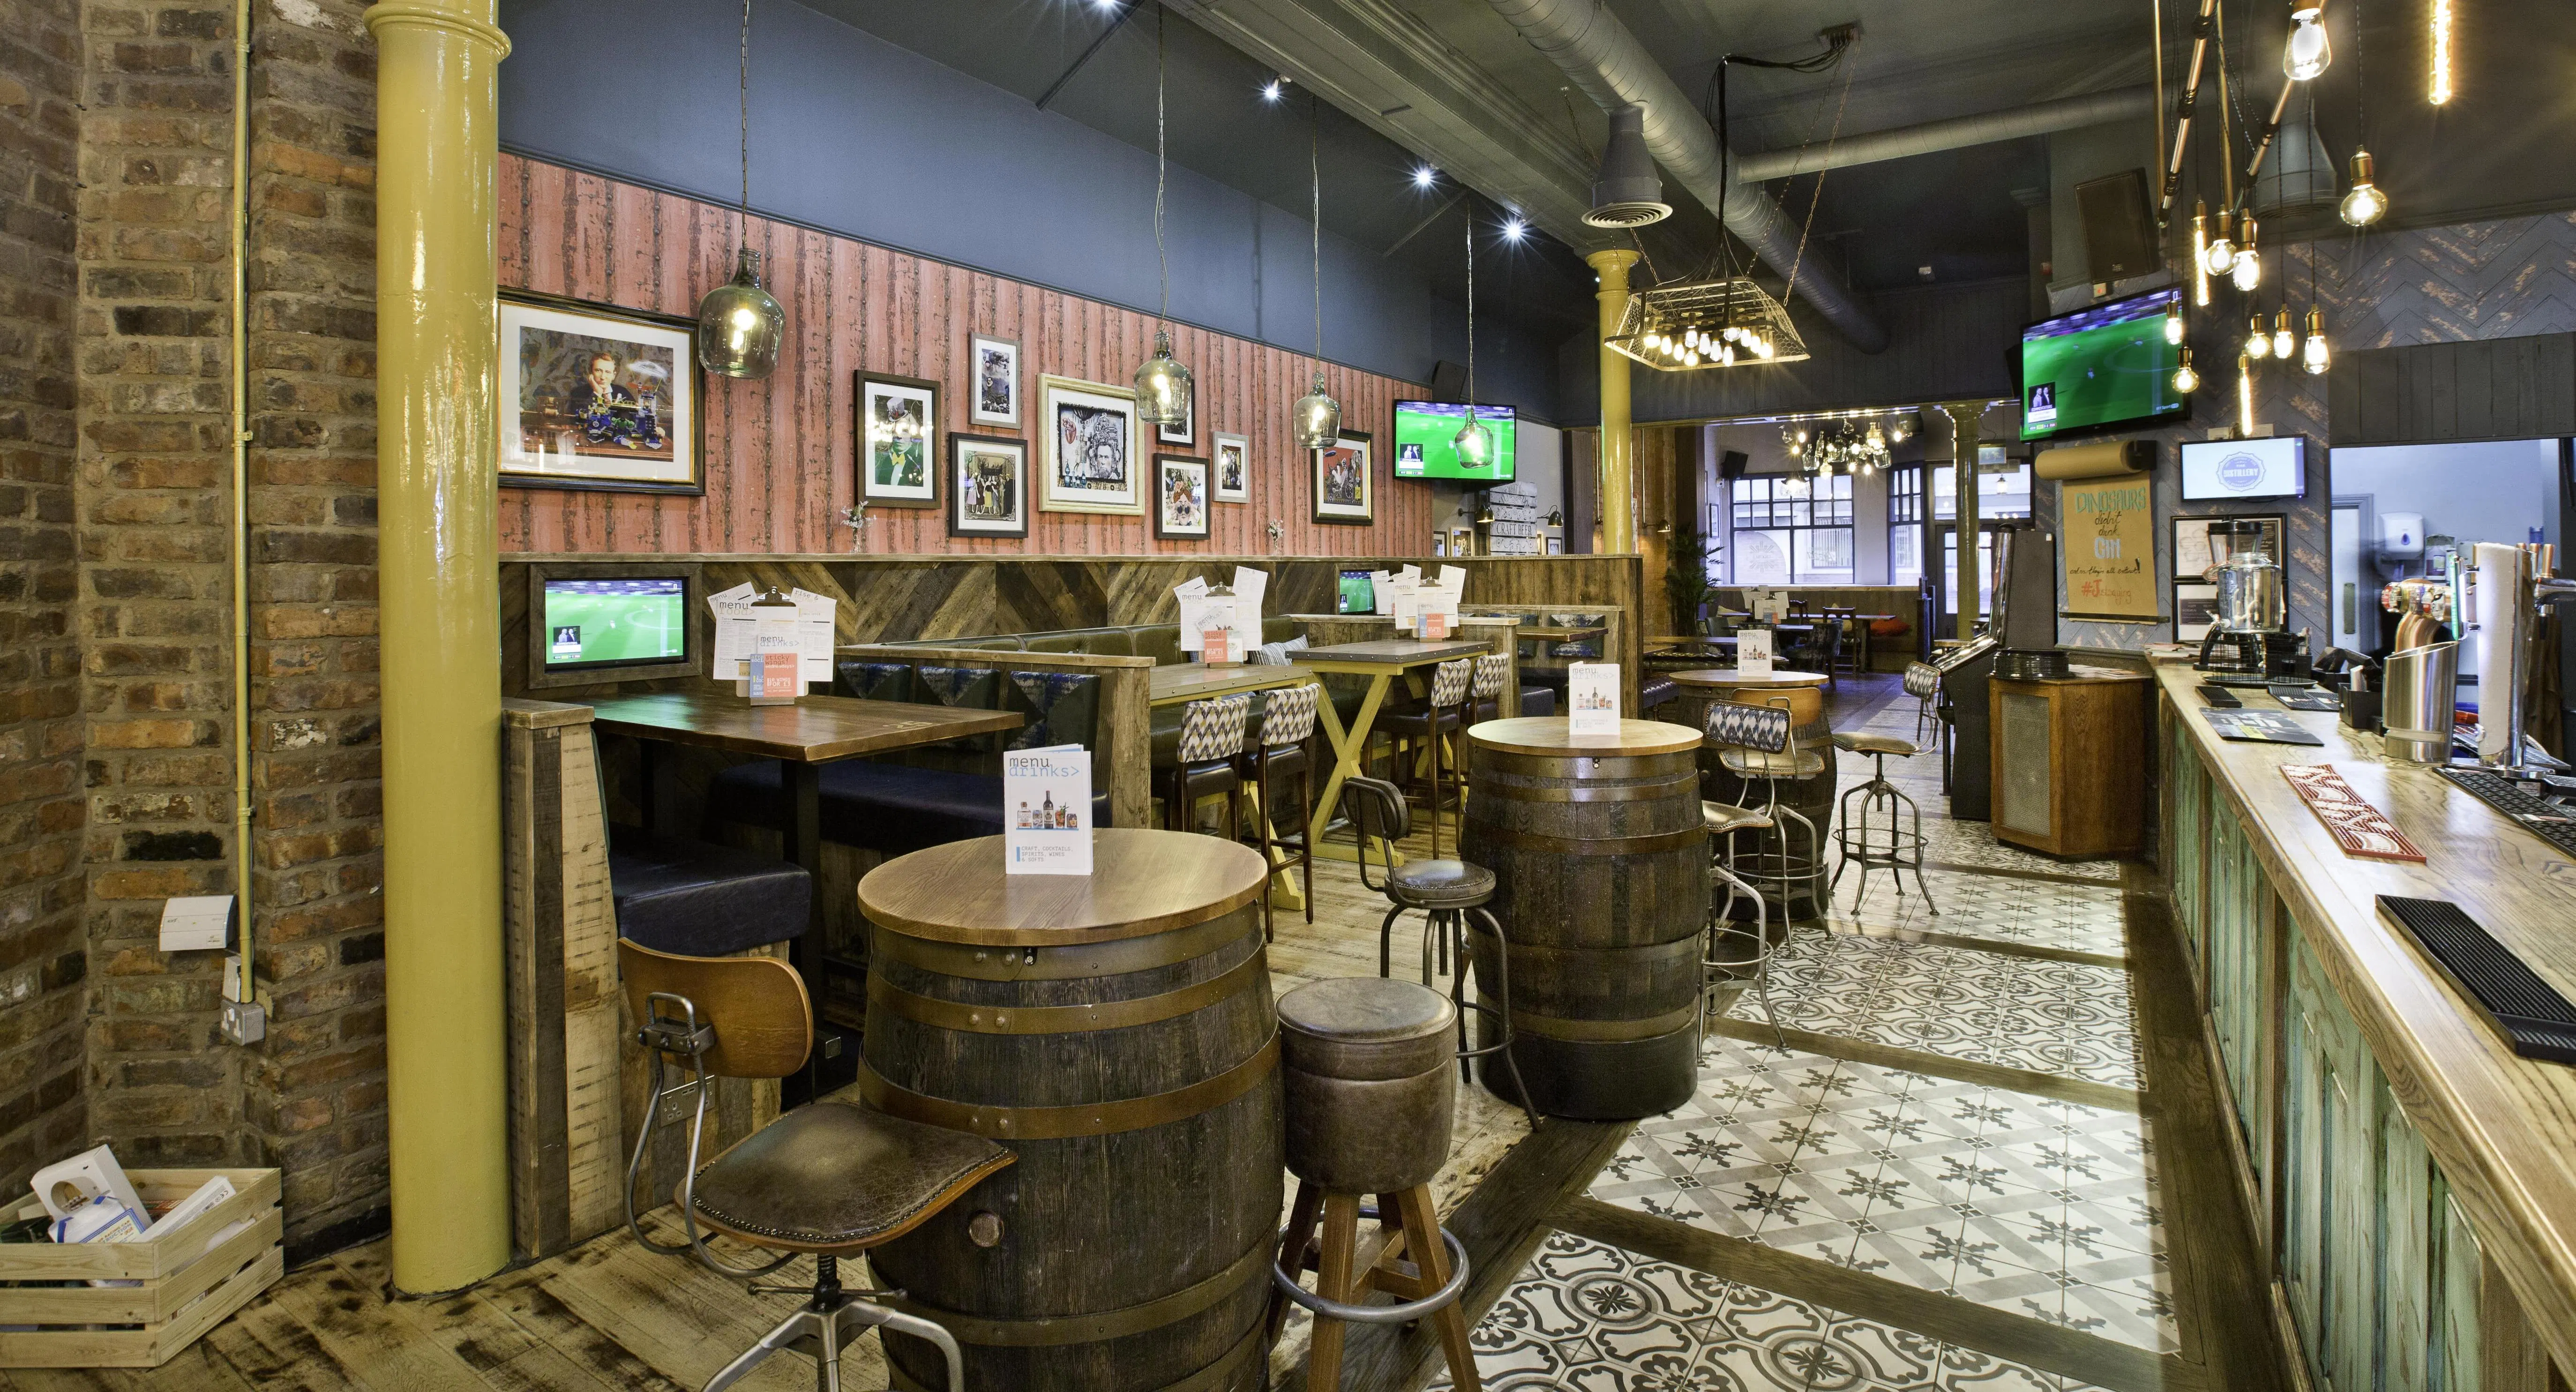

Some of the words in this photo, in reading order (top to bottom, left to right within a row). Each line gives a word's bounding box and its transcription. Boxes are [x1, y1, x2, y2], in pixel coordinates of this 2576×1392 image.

[2076, 487, 2146, 513] DINOSAURS
[1497, 523, 1517, 535] CRAFT
[1518, 525, 1532, 536] BEER
[710, 593, 727, 602] menu
[1198, 614, 1212, 626] menu
[1009, 757, 1050, 767] menu
[1009, 764, 1079, 777] drinks>
